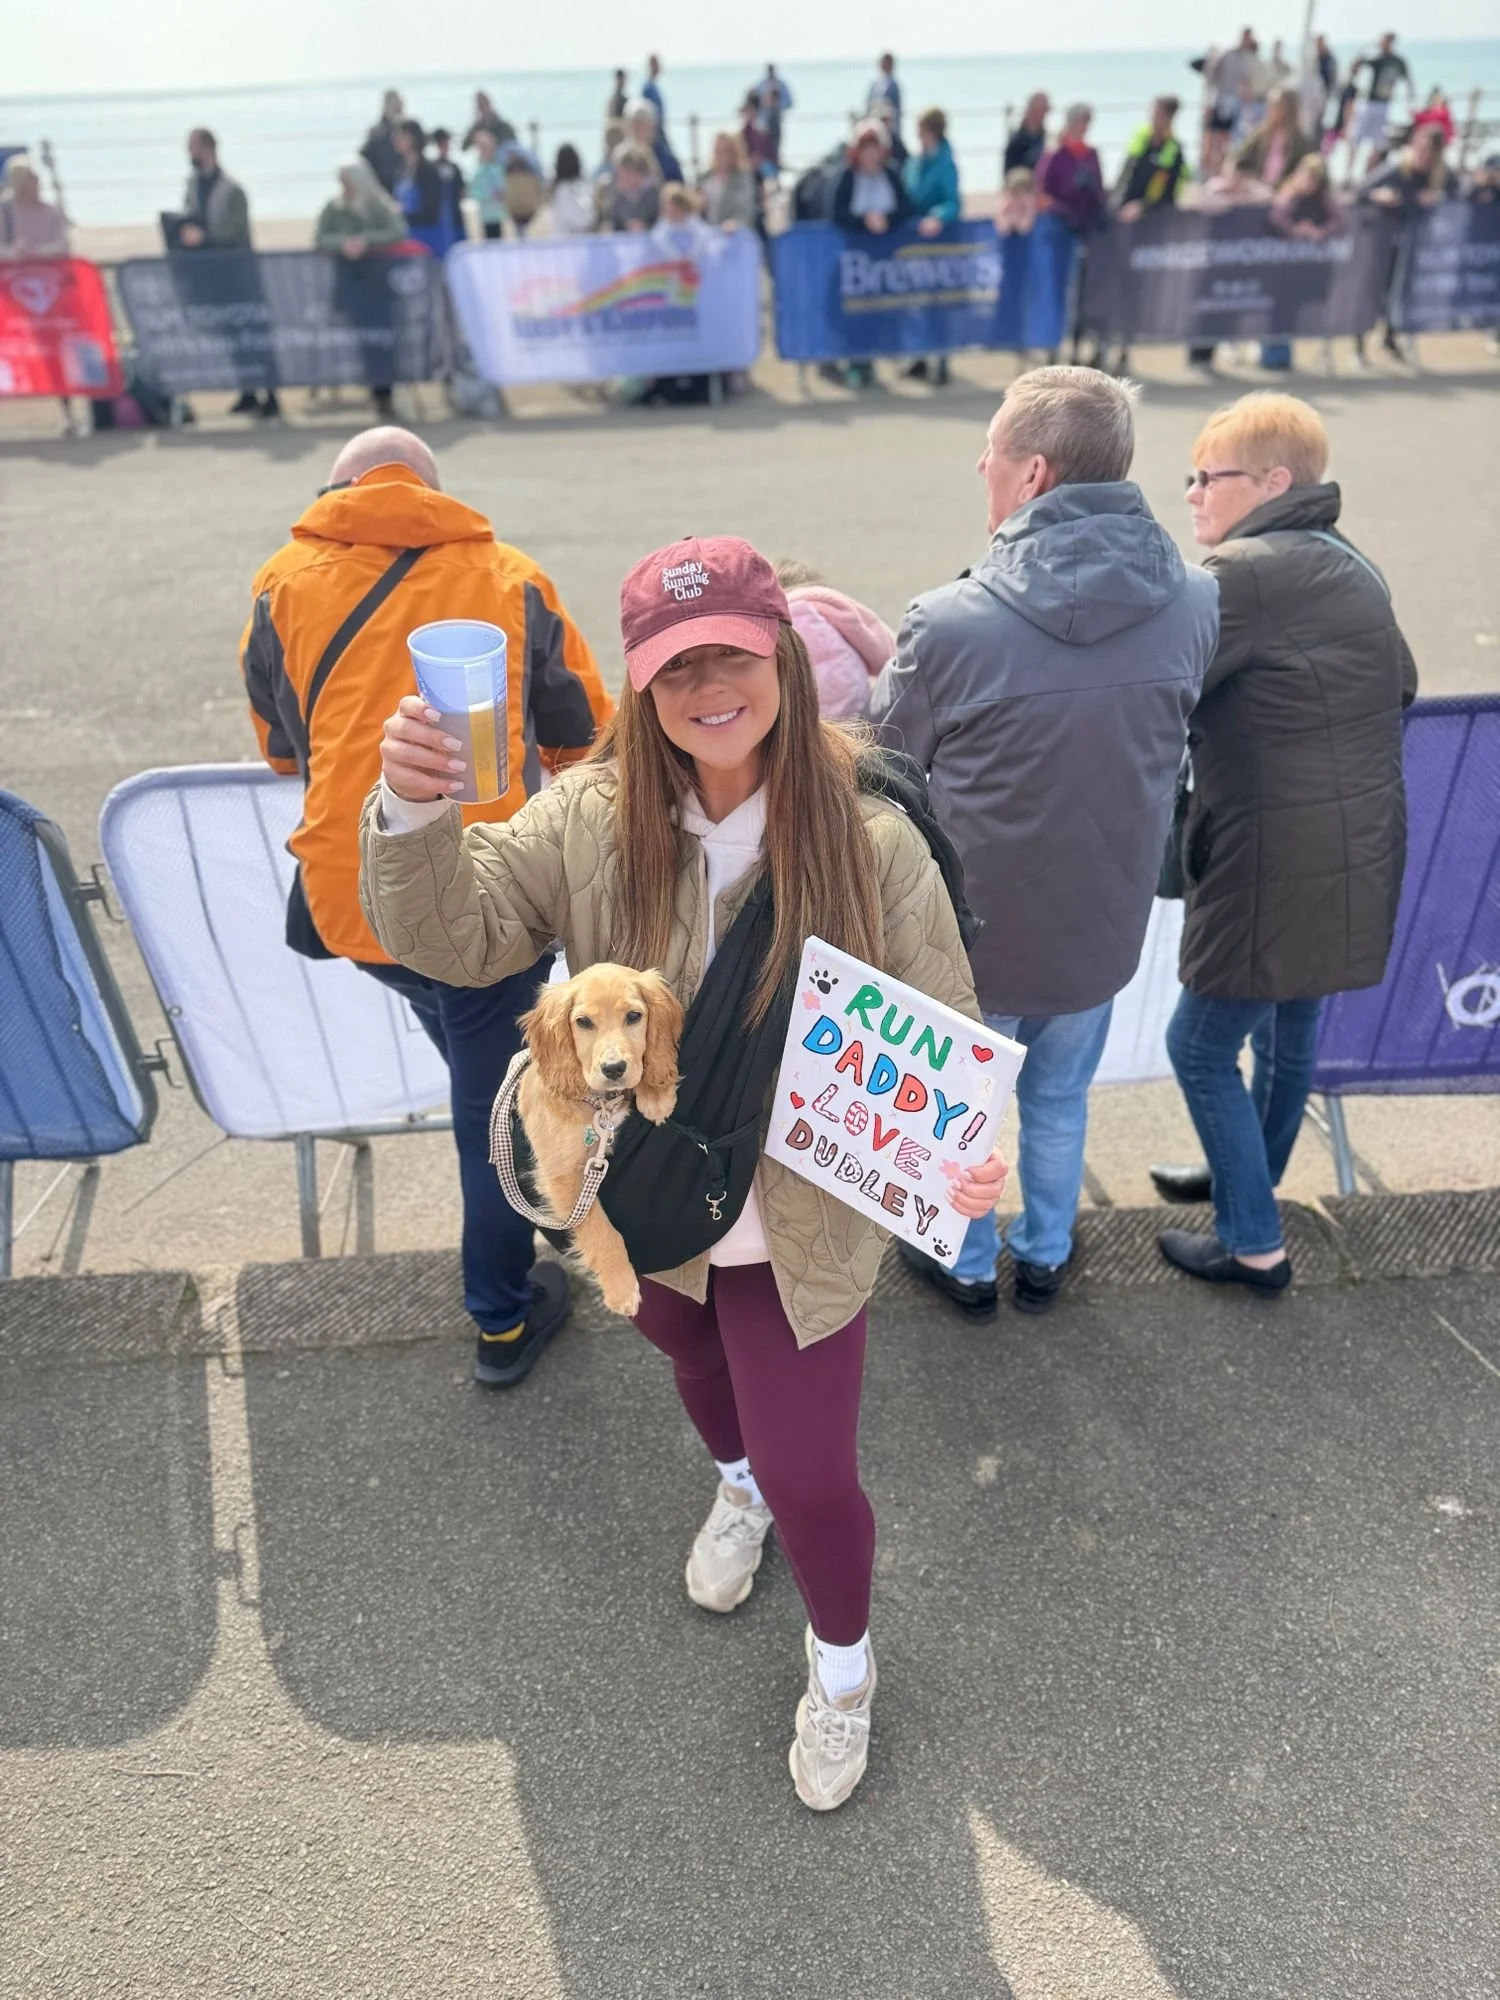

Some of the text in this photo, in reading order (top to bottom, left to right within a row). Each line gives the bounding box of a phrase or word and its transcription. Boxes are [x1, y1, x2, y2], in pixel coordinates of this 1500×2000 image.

[840, 250, 1003, 295] Brewers
[661, 571, 710, 592] Running
[662, 561, 703, 579] Sunday
[674, 585, 702, 600] Club
[843, 983, 953, 1072] RUN
[802, 1014, 987, 1151] DADDY!
[811, 1083, 932, 1180] LOVE
[785, 1117, 940, 1236] DUDLEY
